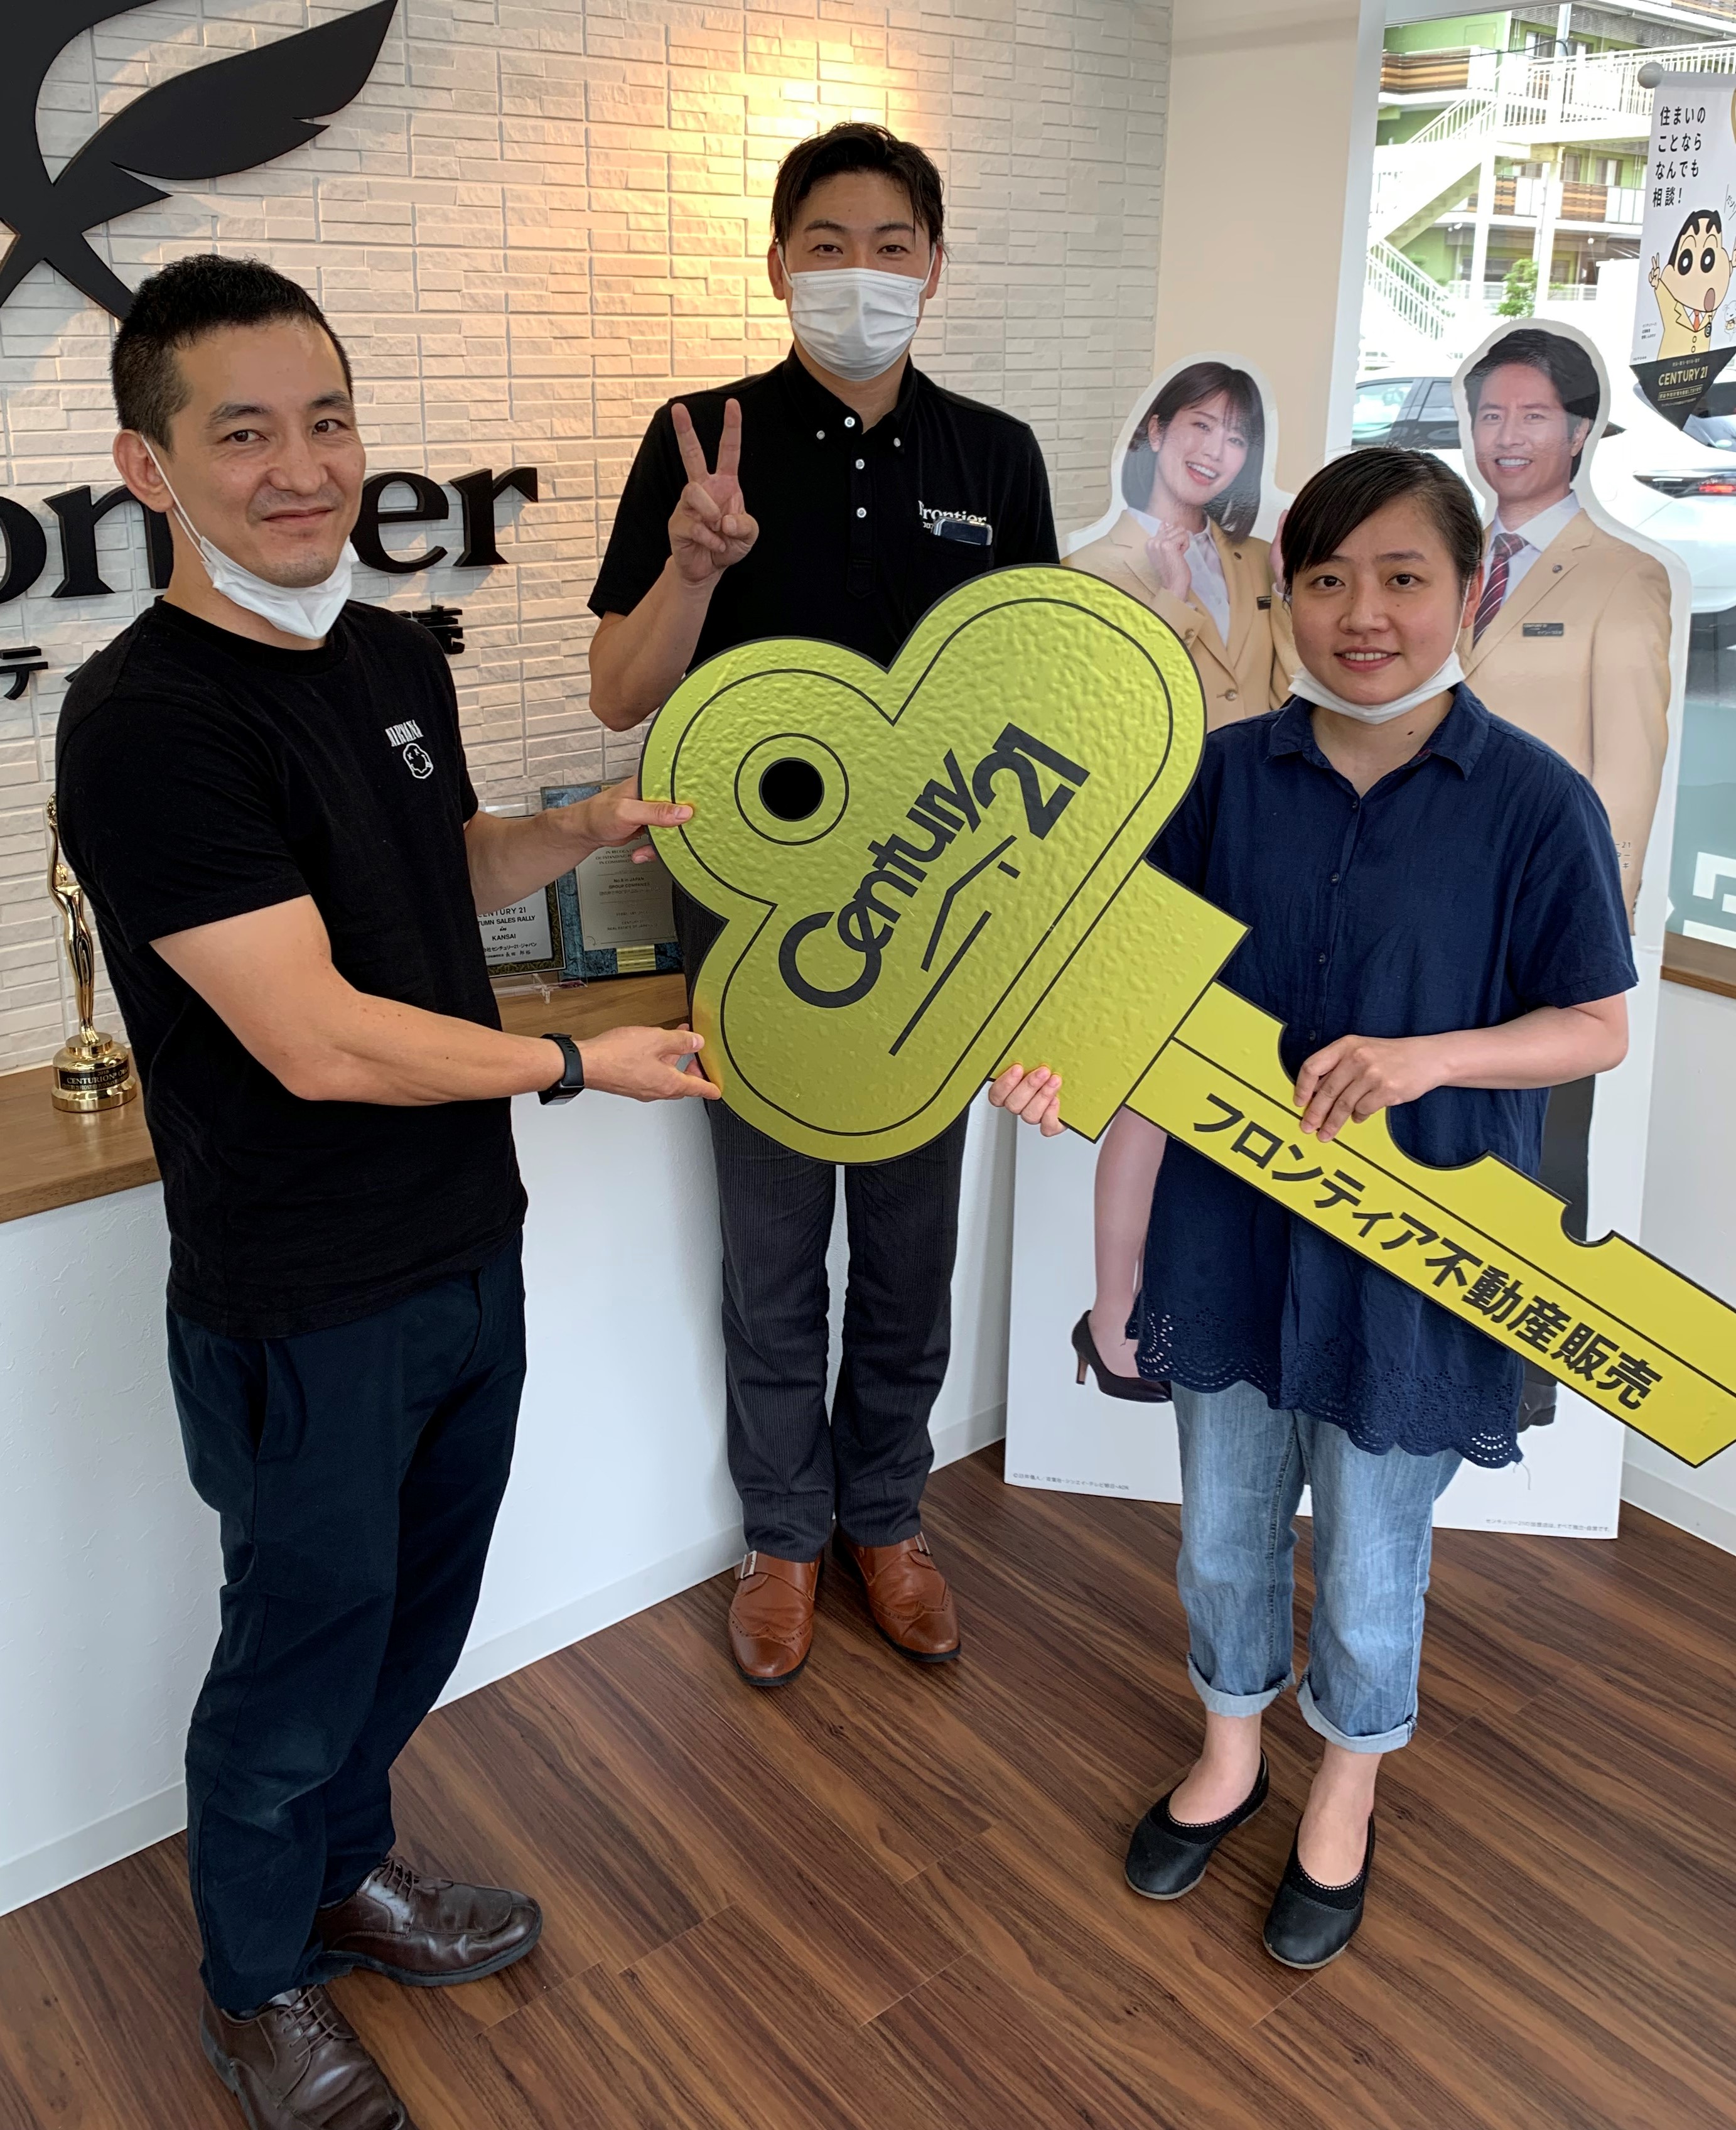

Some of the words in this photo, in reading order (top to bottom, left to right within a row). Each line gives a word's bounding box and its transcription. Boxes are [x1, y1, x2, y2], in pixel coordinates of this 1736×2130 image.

[1660, 106, 1706, 126] 住まいの
[1658, 132, 1701, 153] ことなら
[1656, 159, 1698, 180] なんでも
[1652, 187, 1683, 207] 相談！
[1658, 367, 1700, 386] CENTURY
[1700, 365, 1708, 379] 21
[385, 720, 424, 747] NIRVANA
[778, 748, 981, 1008] Century
[972, 722, 1091, 840] 21
[1193, 1093, 1663, 1410] フロンティア不動産販売
